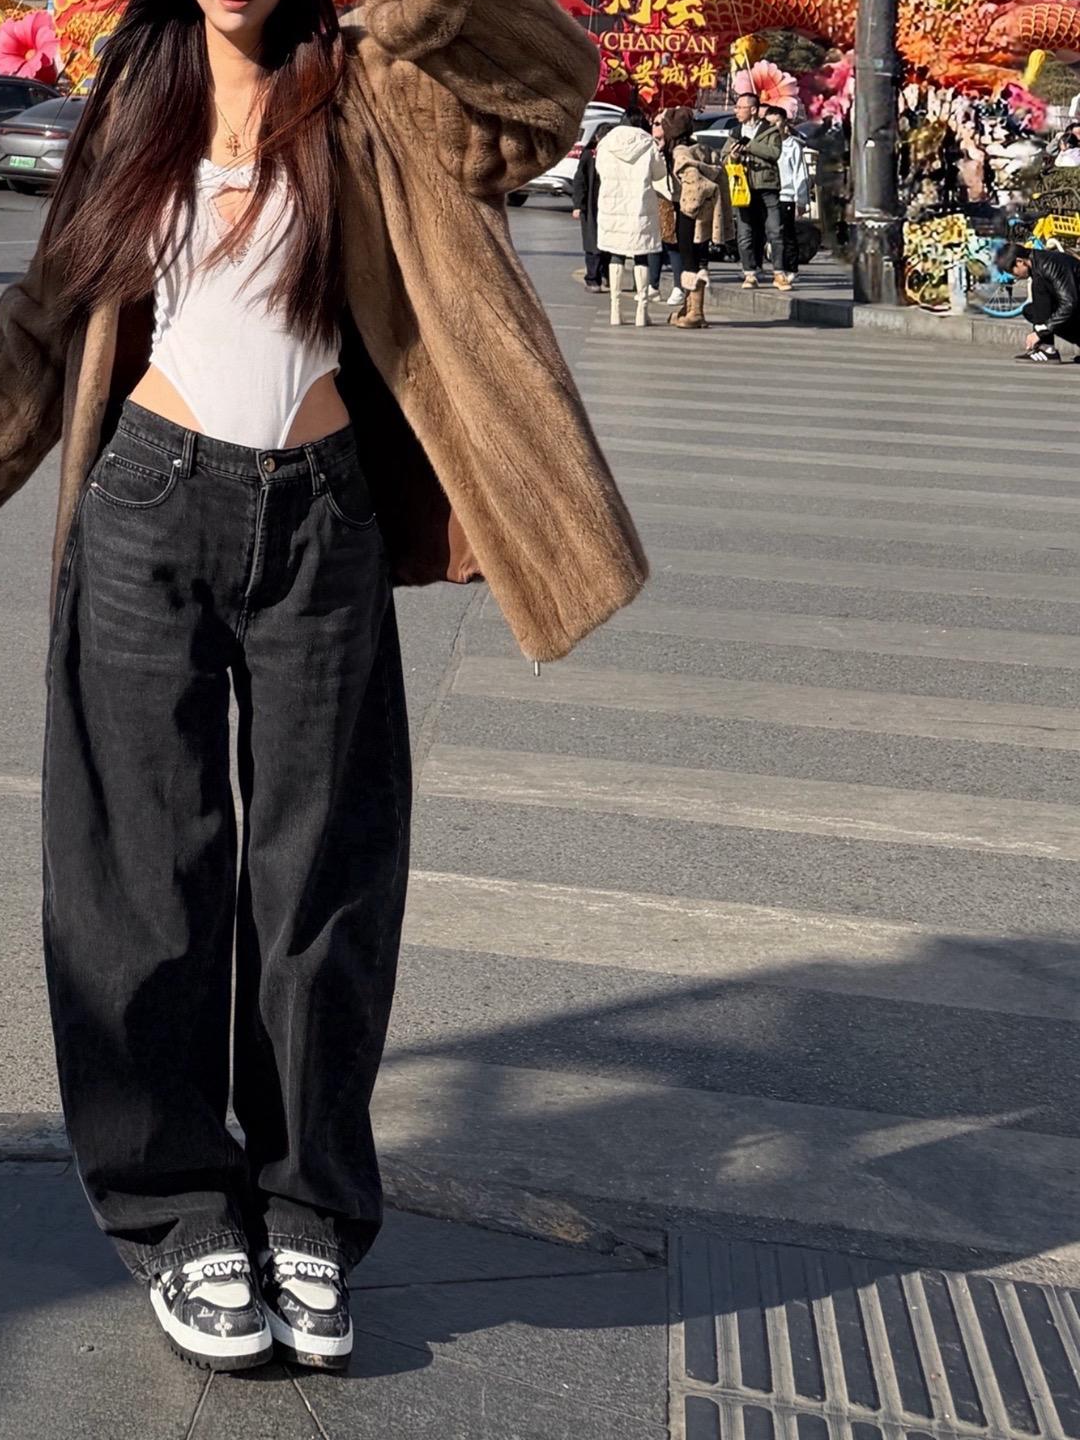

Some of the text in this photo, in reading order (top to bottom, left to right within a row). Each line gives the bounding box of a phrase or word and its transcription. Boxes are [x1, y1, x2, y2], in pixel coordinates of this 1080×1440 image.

[604, 32, 718, 53] CHANG'AN
[606, 57, 717, 89] 西安城墙
[213, 1261, 233, 1276] LV
[307, 1263, 325, 1278] LV
